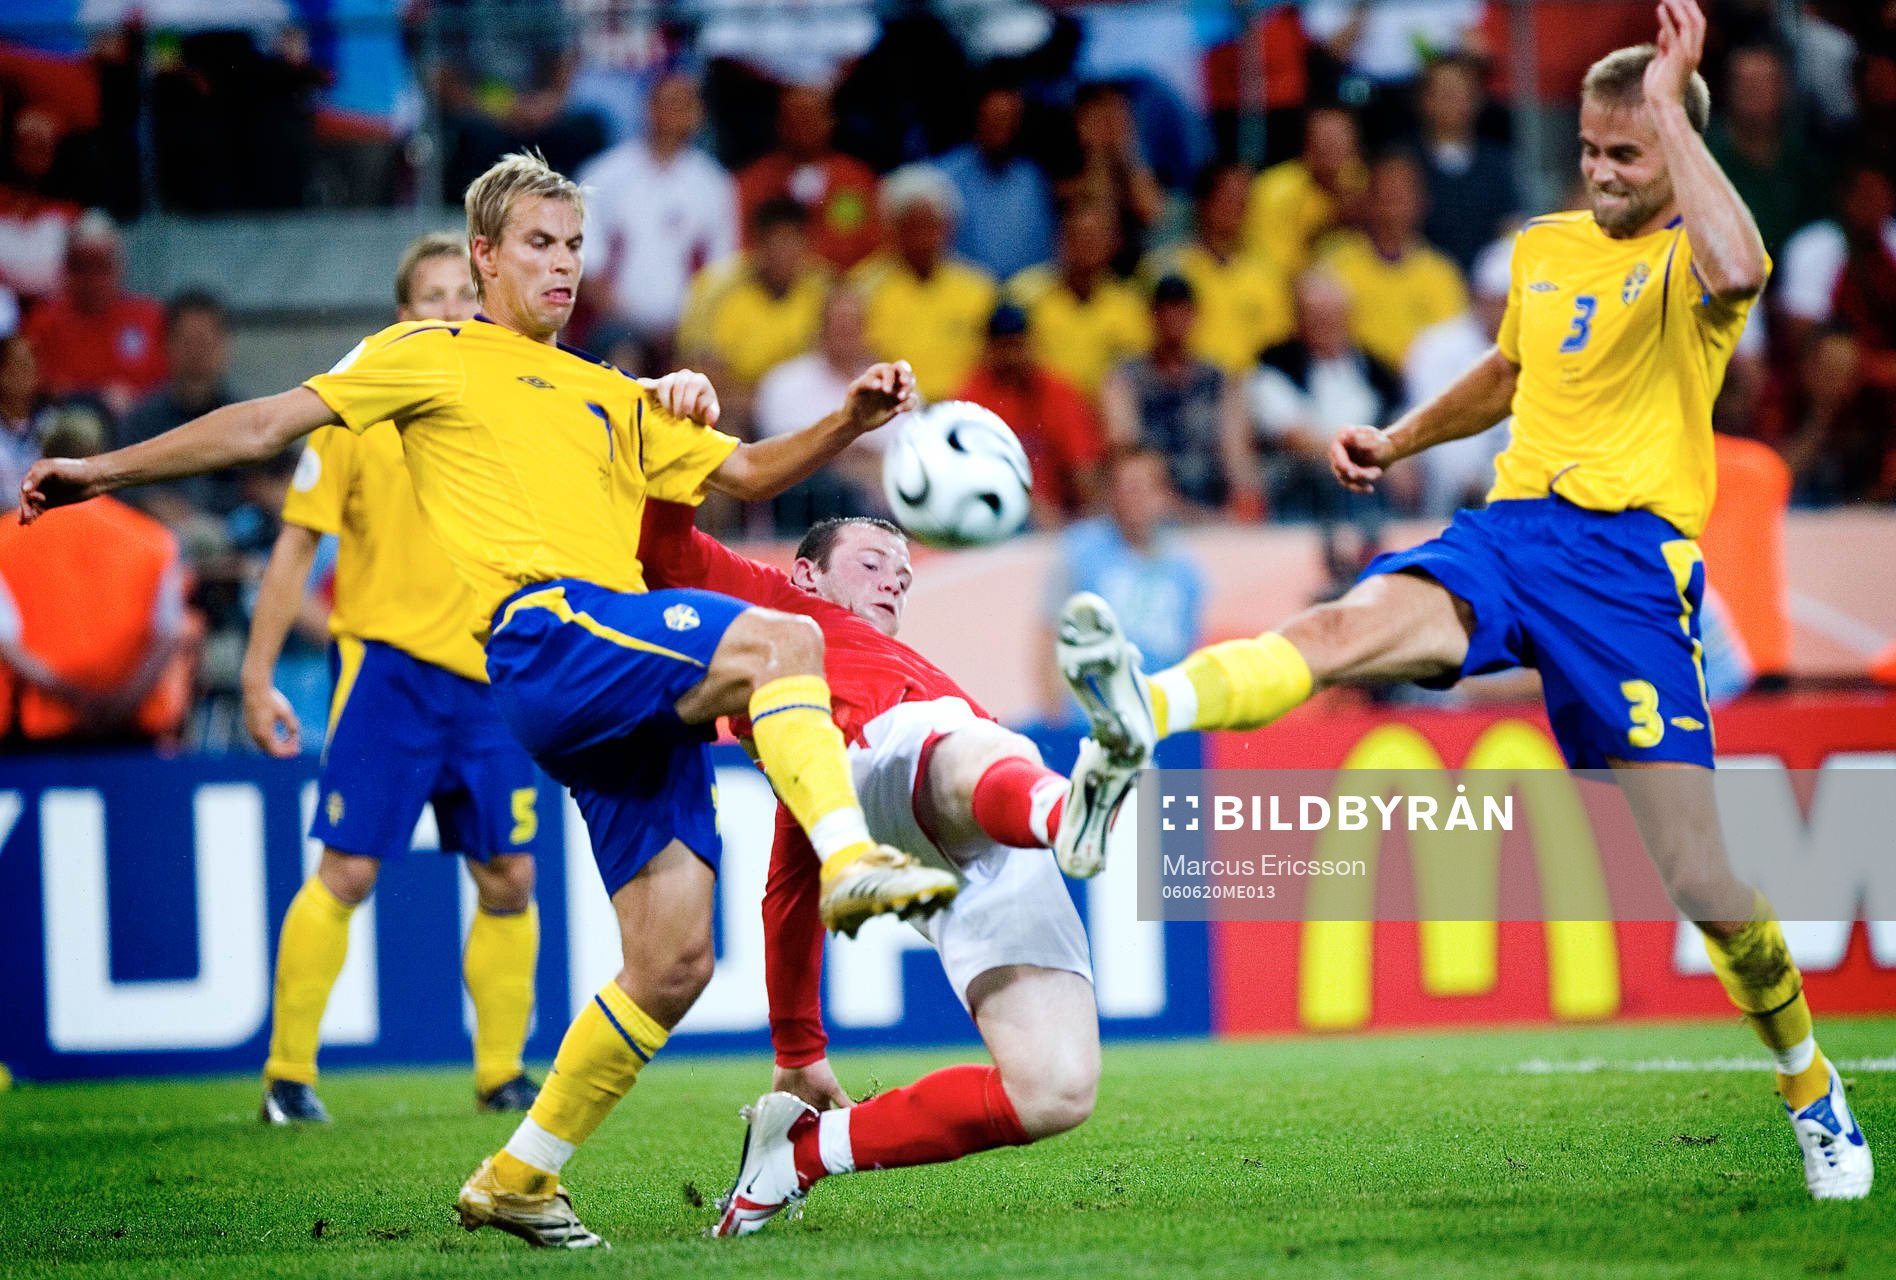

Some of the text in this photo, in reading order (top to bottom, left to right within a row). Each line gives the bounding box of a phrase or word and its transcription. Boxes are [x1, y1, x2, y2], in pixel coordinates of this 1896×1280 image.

[1559, 295, 1597, 353] 3
[1620, 679, 1665, 748] 3
[509, 787, 539, 845] 5
